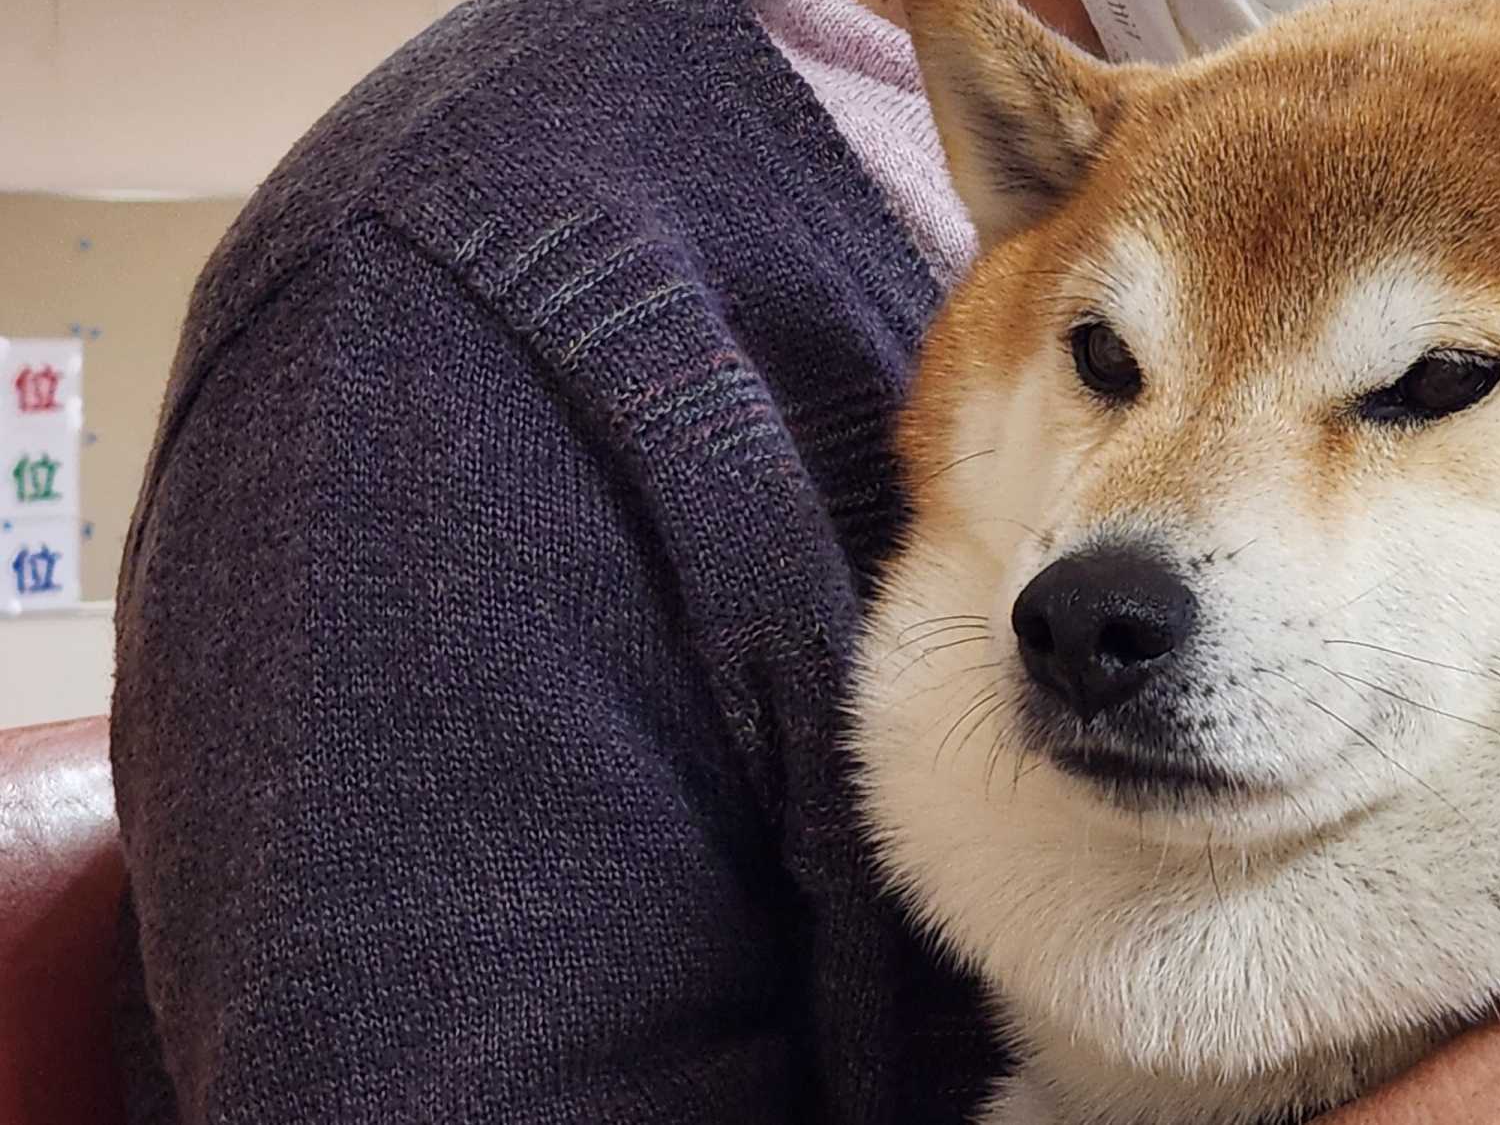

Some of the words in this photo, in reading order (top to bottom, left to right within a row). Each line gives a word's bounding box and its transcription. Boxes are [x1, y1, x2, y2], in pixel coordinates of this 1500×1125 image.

[15, 364, 61, 412] 位
[13, 452, 62, 502] 位
[13, 544, 62, 594] 位
